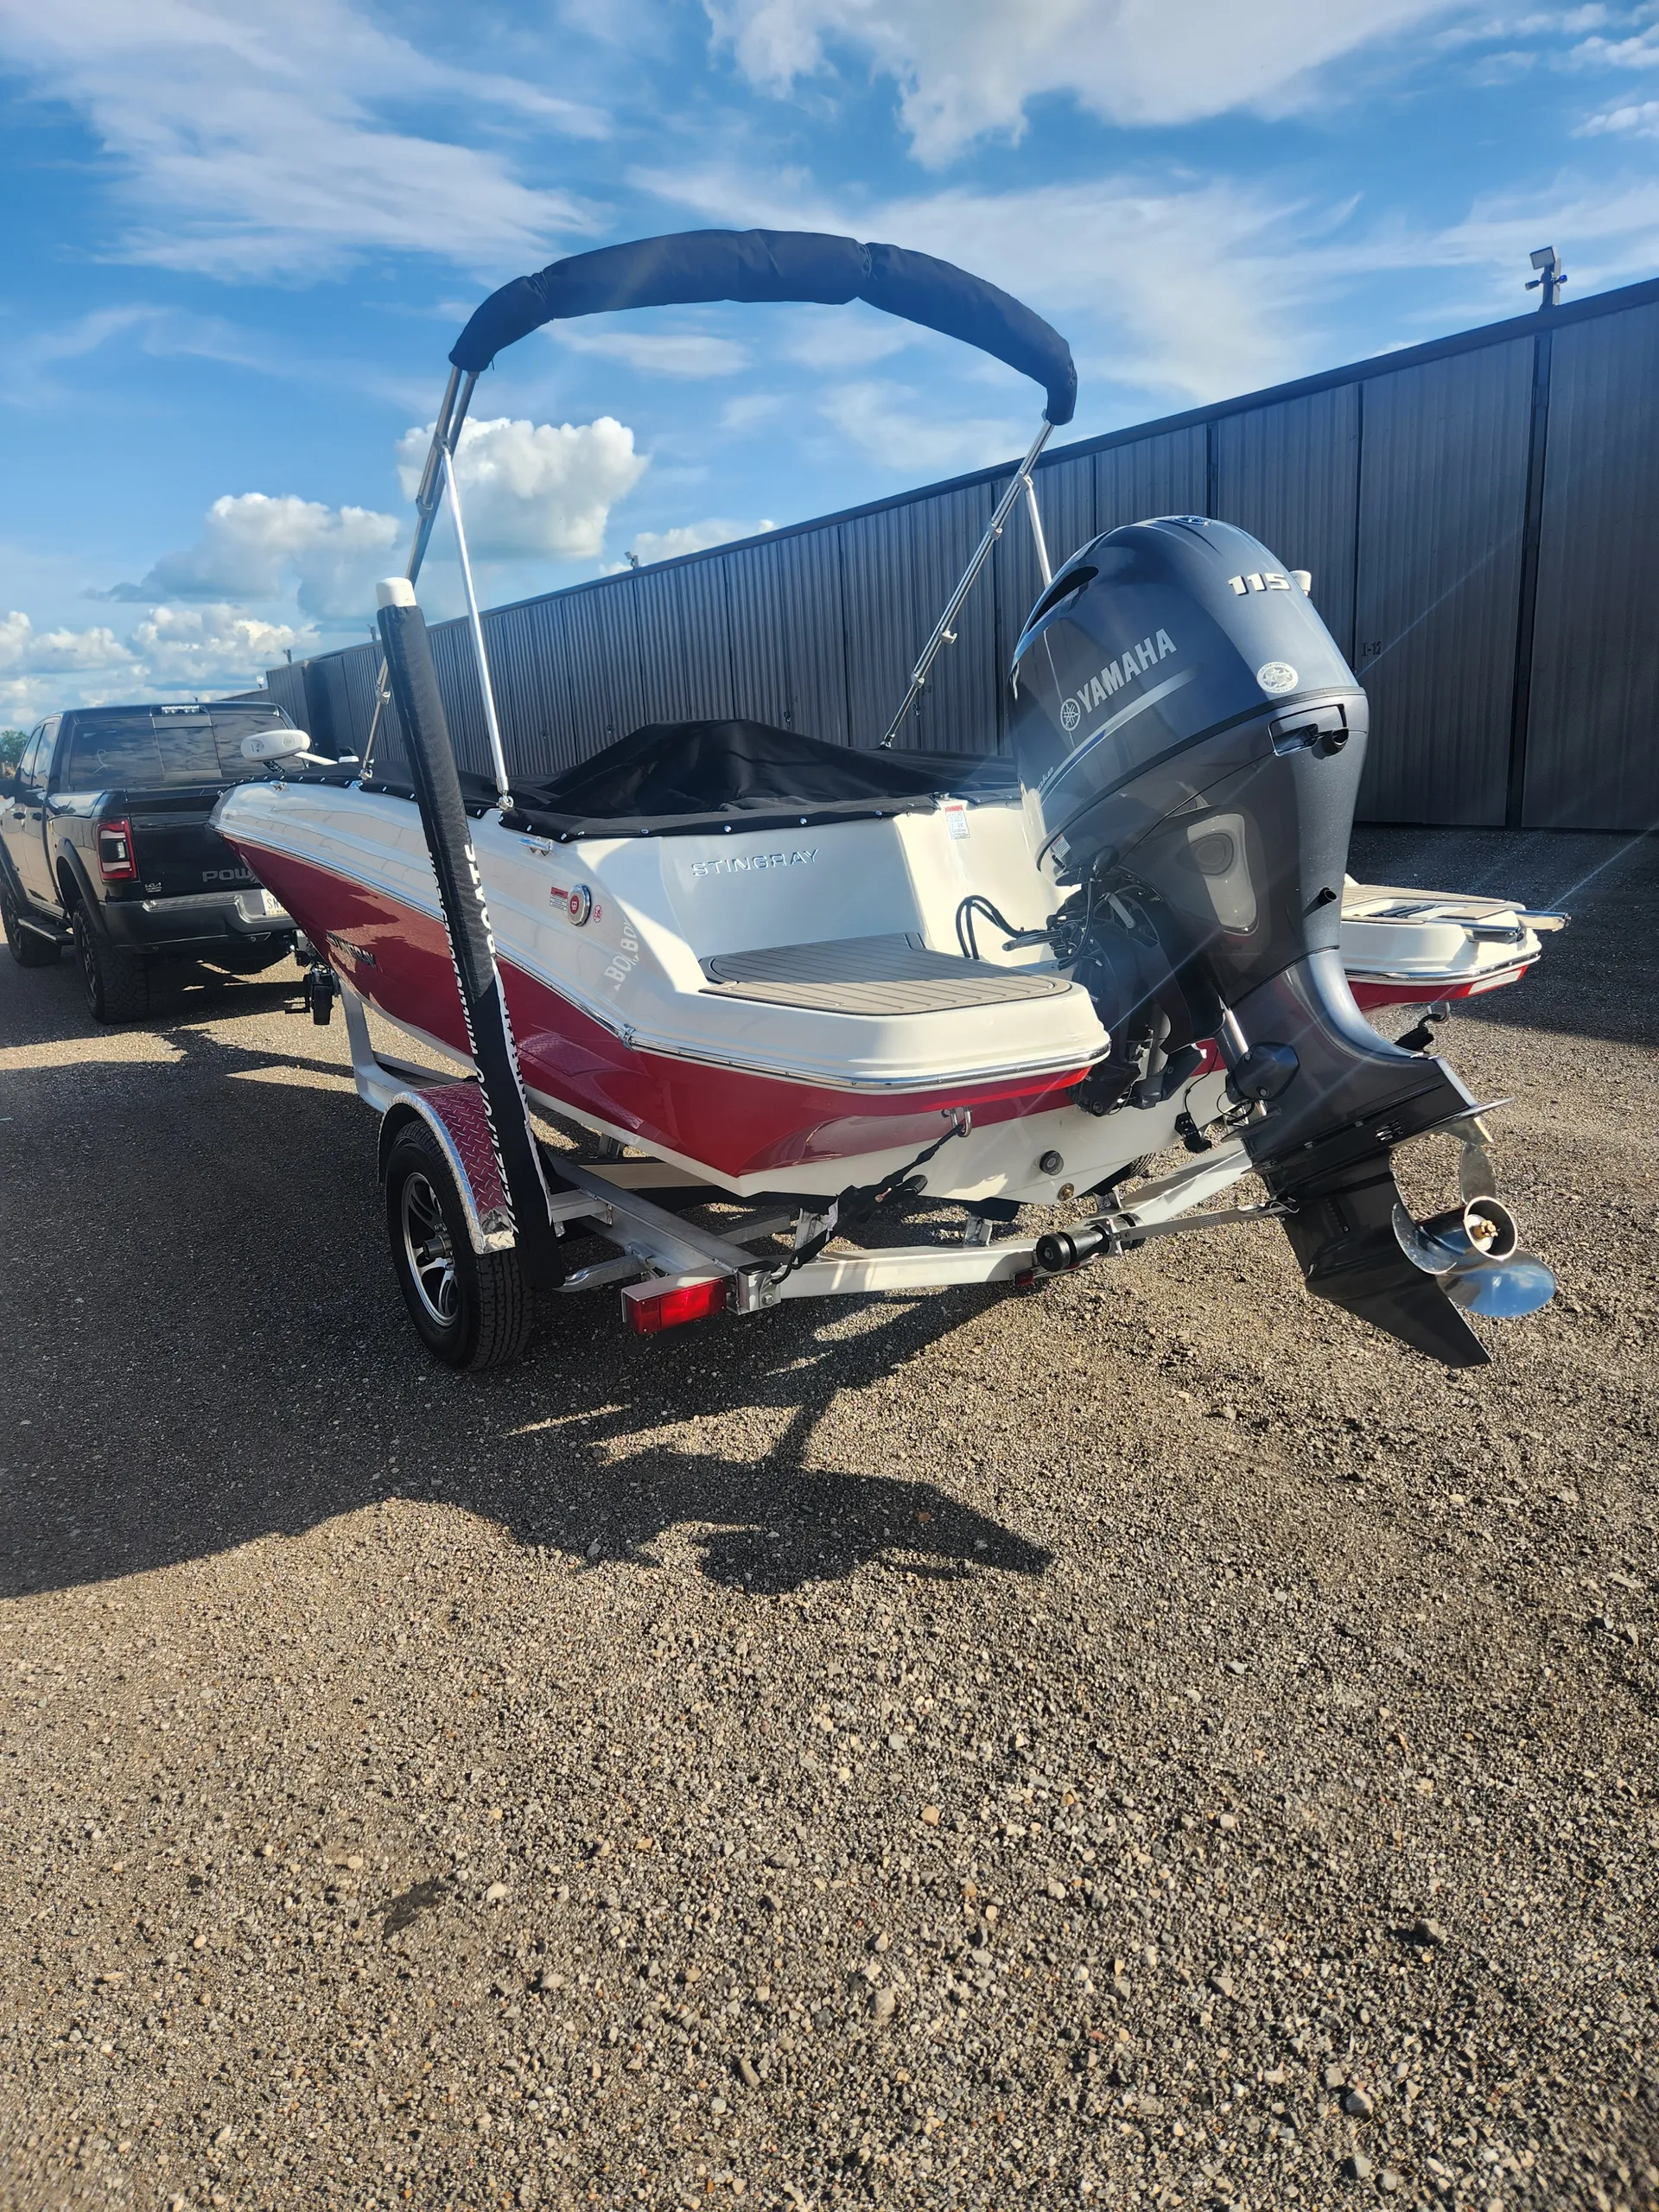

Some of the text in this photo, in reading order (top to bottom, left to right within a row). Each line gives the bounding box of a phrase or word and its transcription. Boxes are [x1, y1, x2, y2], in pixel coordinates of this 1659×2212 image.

[1228, 572, 1291, 595] 115
[1076, 627, 1178, 714] YAMAHA
[691, 849, 819, 877] STINGRAY
